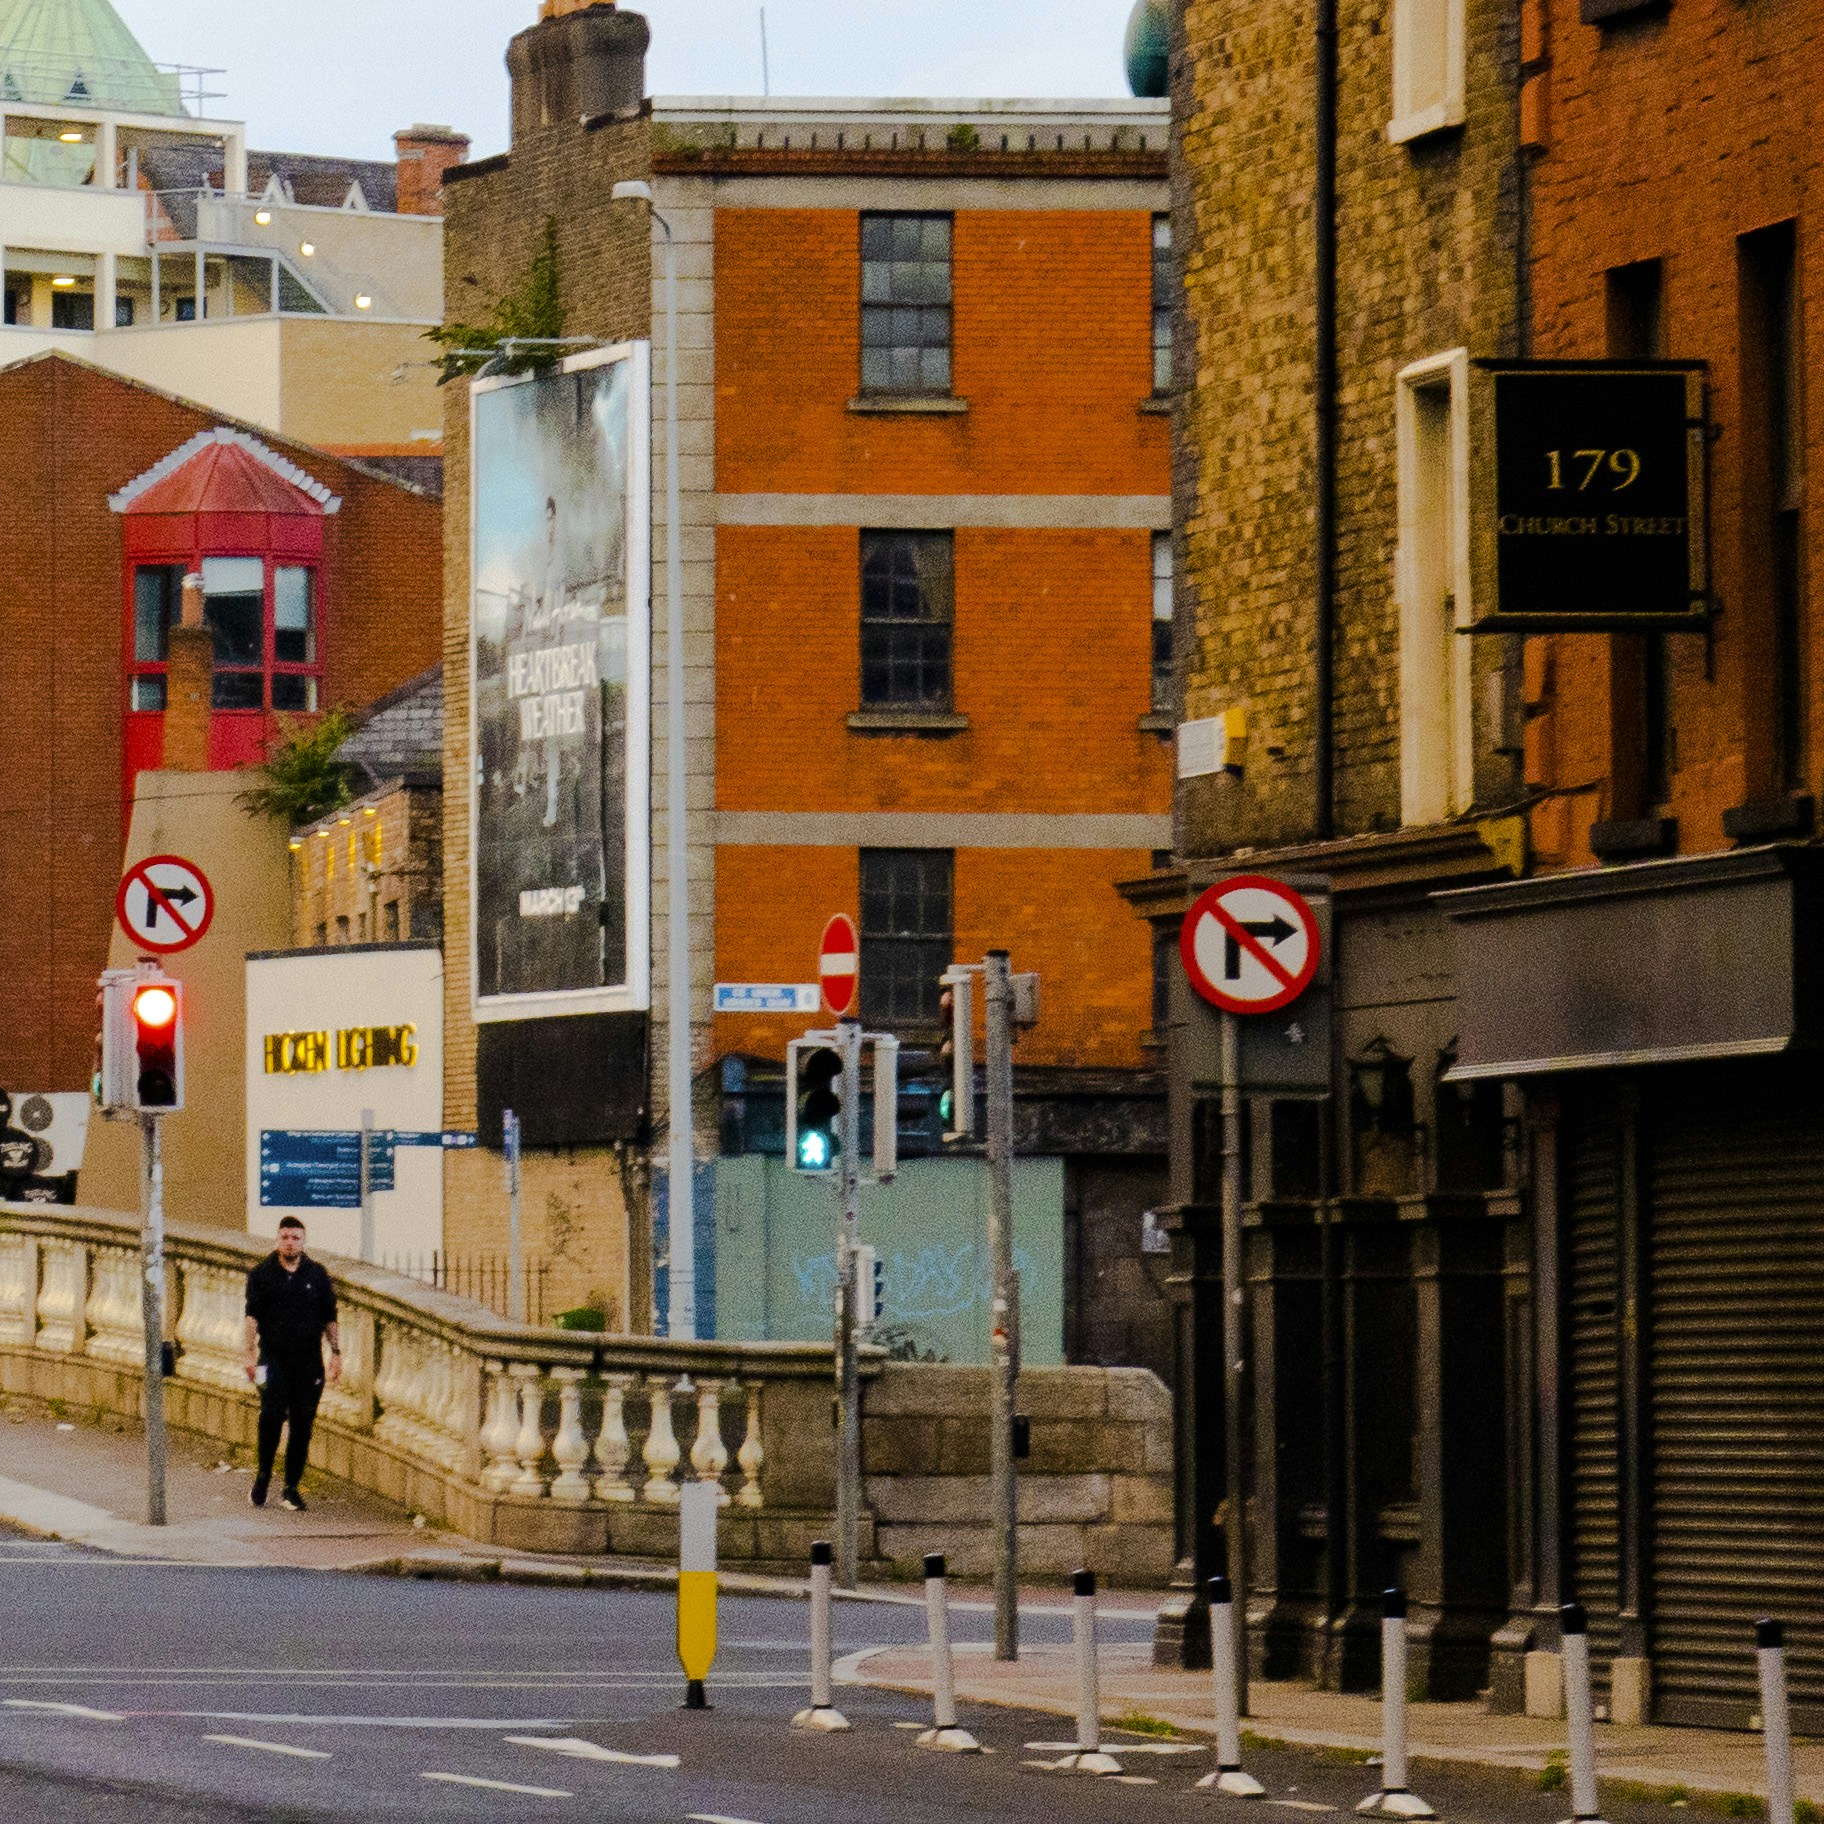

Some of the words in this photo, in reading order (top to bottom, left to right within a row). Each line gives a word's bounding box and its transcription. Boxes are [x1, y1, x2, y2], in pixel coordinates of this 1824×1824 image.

[1544, 448, 1642, 492] 179
[1500, 513, 1598, 536] CHURCH
[1605, 513, 1686, 536] STREET
[507, 641, 599, 699] HEARTBREAK
[519, 689, 586, 741] WEATHER
